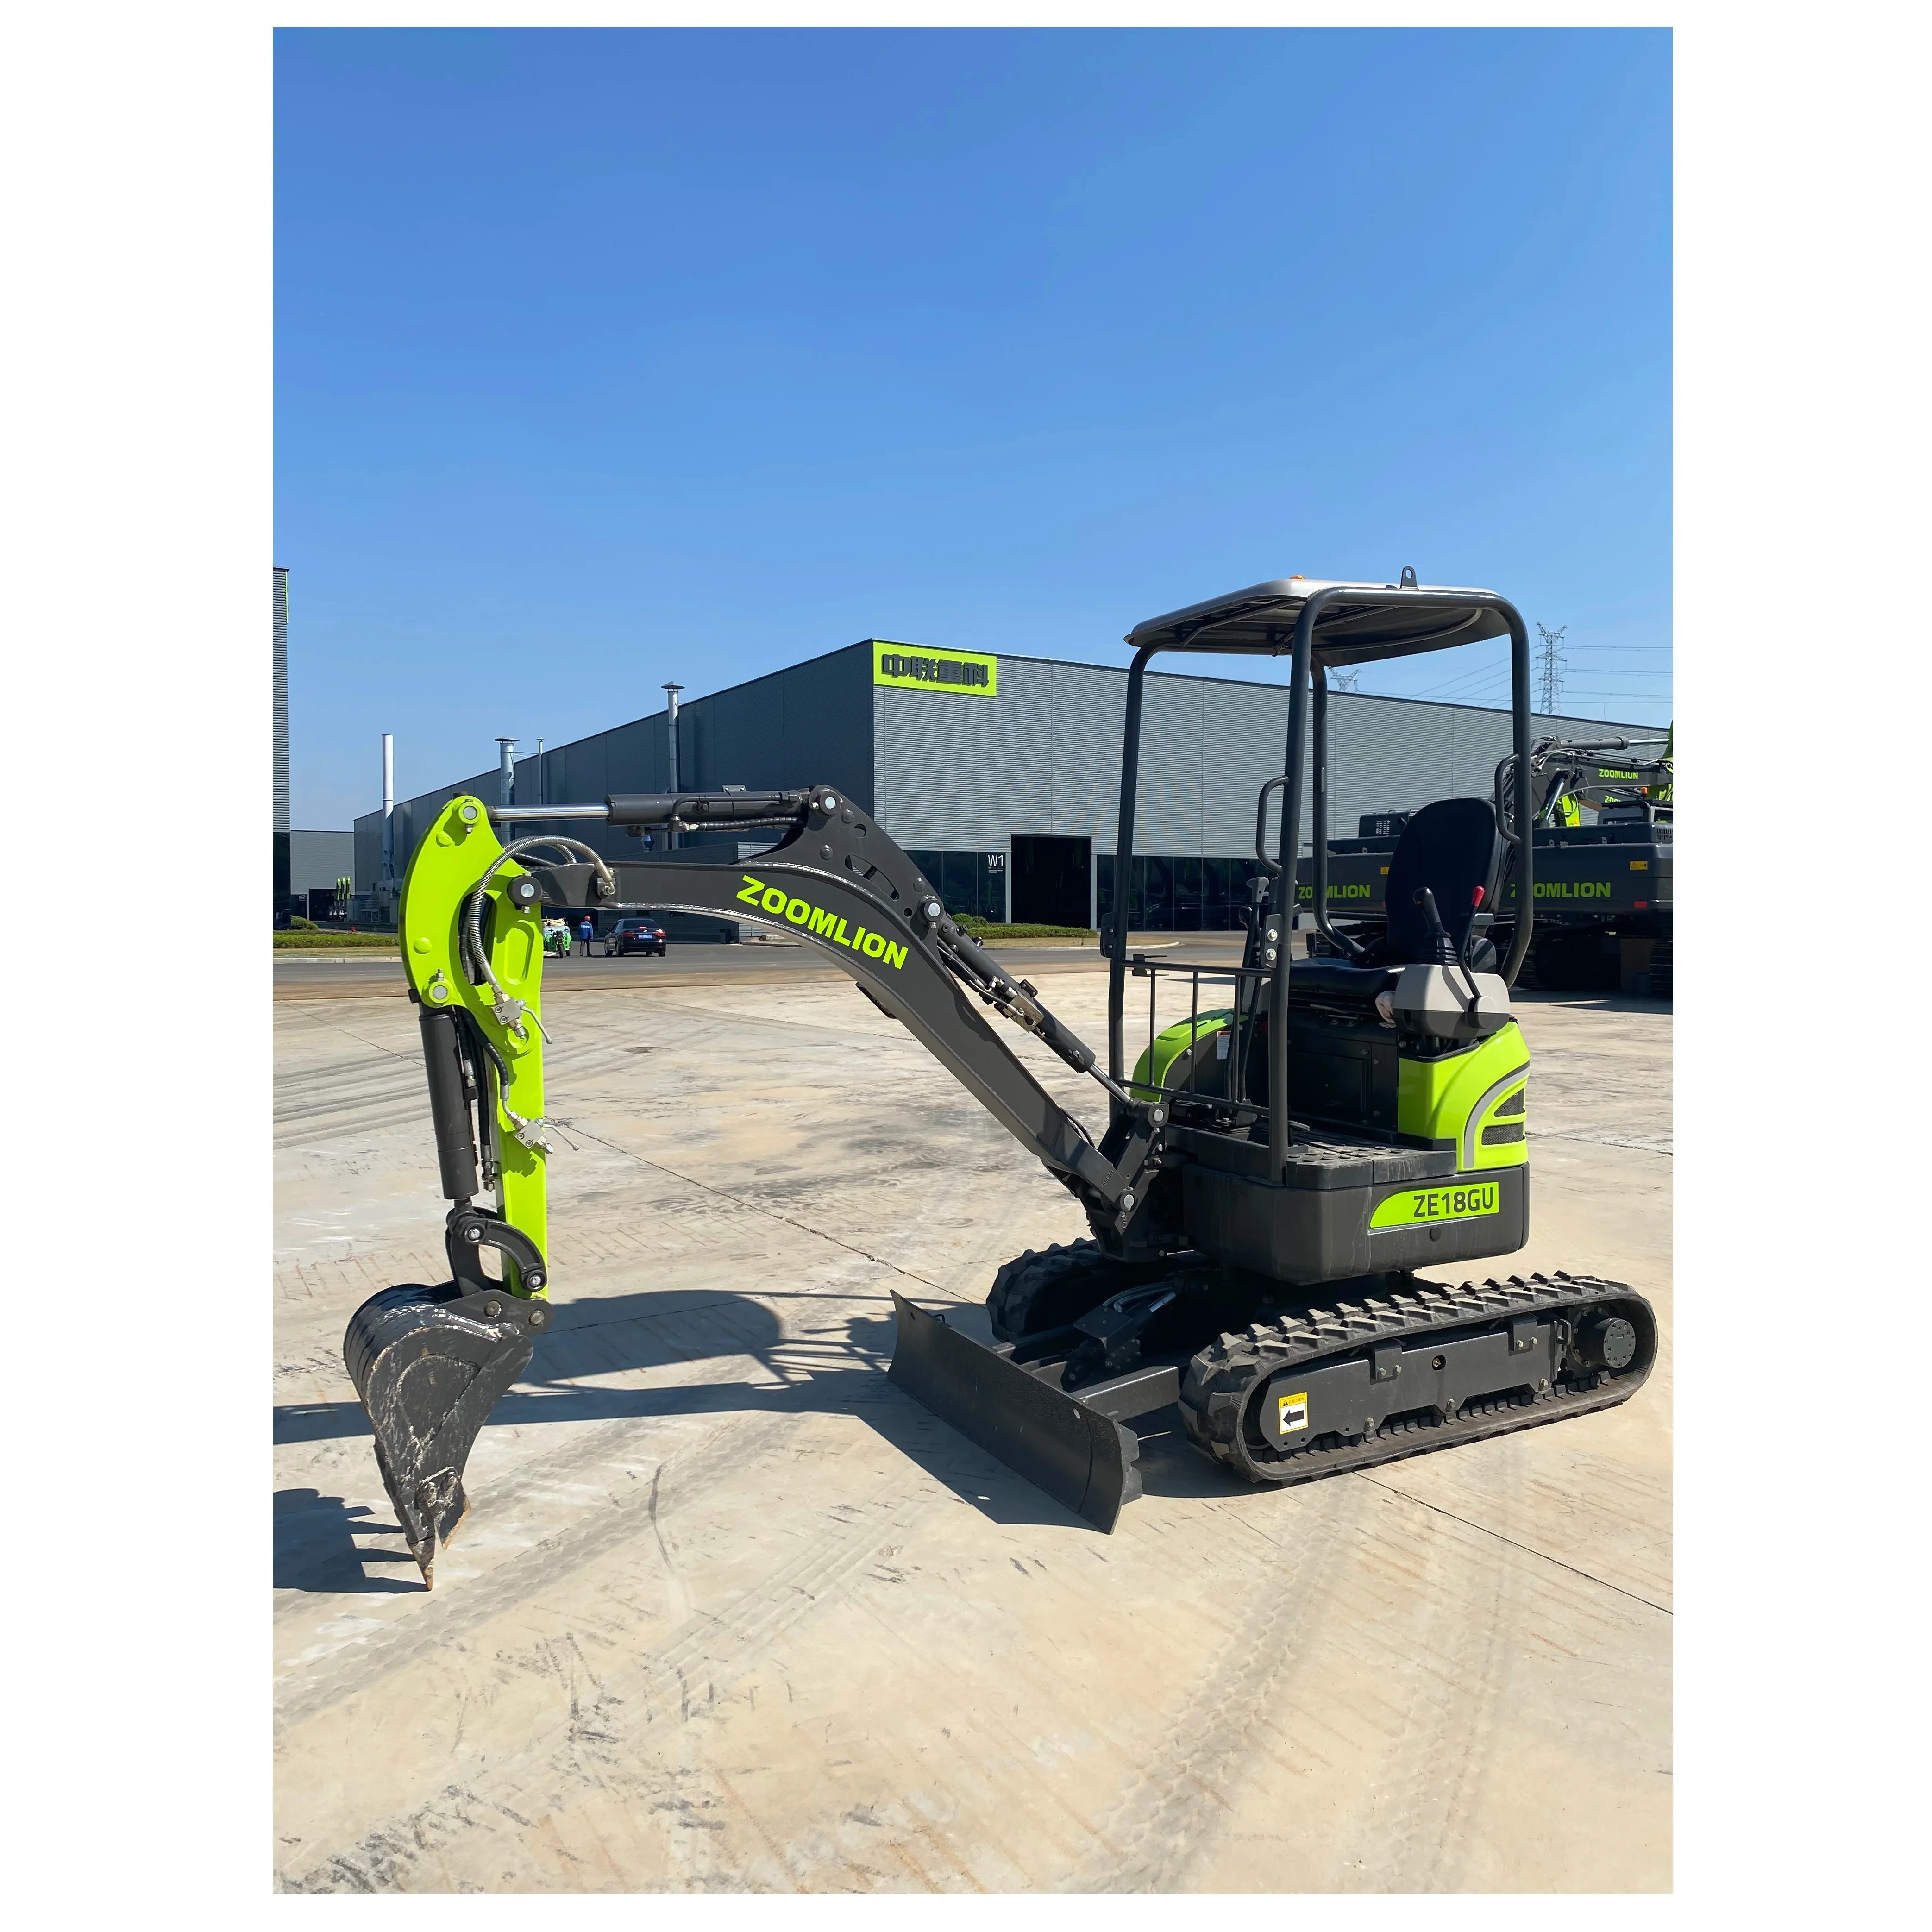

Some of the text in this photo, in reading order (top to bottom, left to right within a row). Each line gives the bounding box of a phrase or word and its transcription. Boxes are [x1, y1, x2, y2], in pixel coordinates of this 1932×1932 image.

[881, 653, 989, 688] 中联重科
[988, 854, 1003, 866] W1
[1298, 885, 1370, 899] ZOMLION
[1511, 882, 1611, 897] OMLION
[735, 874, 909, 970] ZOOMLION
[1413, 1187, 1493, 1218] ZE18GU
